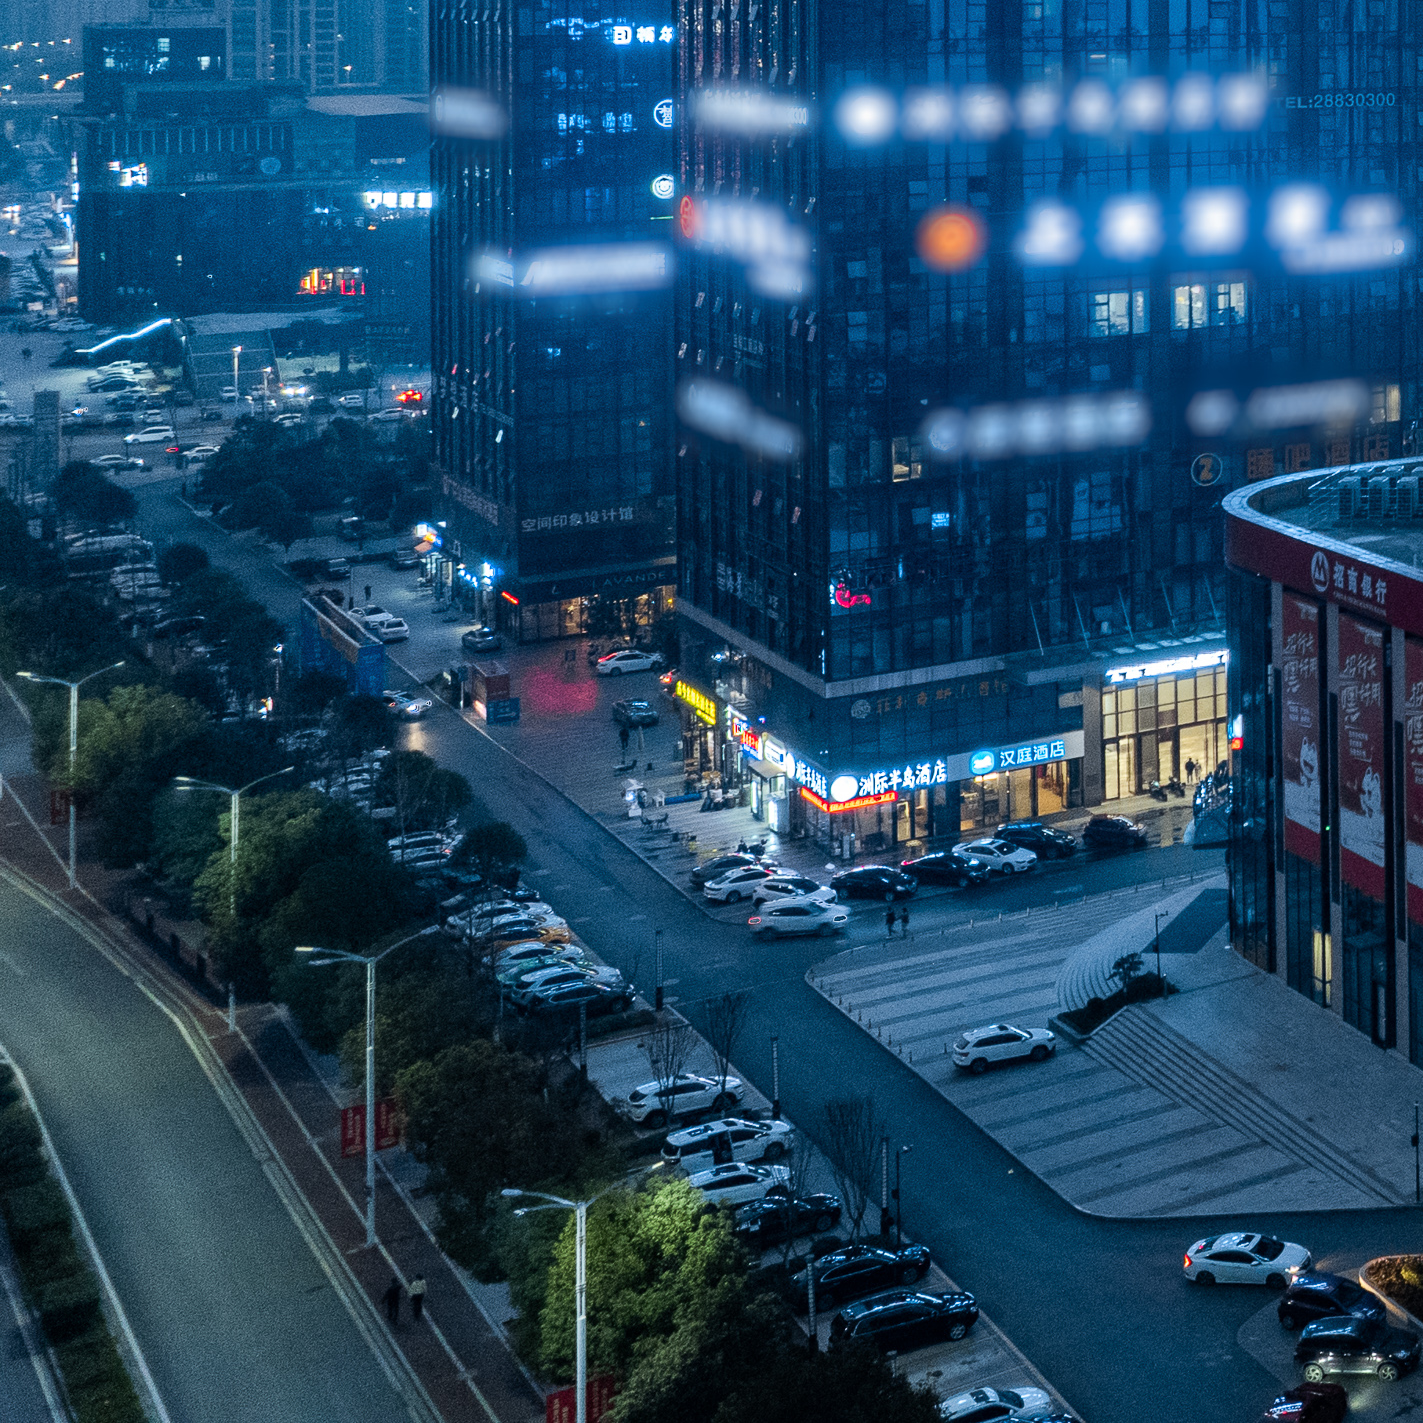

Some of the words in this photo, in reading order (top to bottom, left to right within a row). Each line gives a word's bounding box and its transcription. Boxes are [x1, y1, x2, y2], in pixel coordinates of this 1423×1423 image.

[1333, 561, 1387, 605] 招商银行
[1000, 739, 1065, 768] 汉庭酒店
